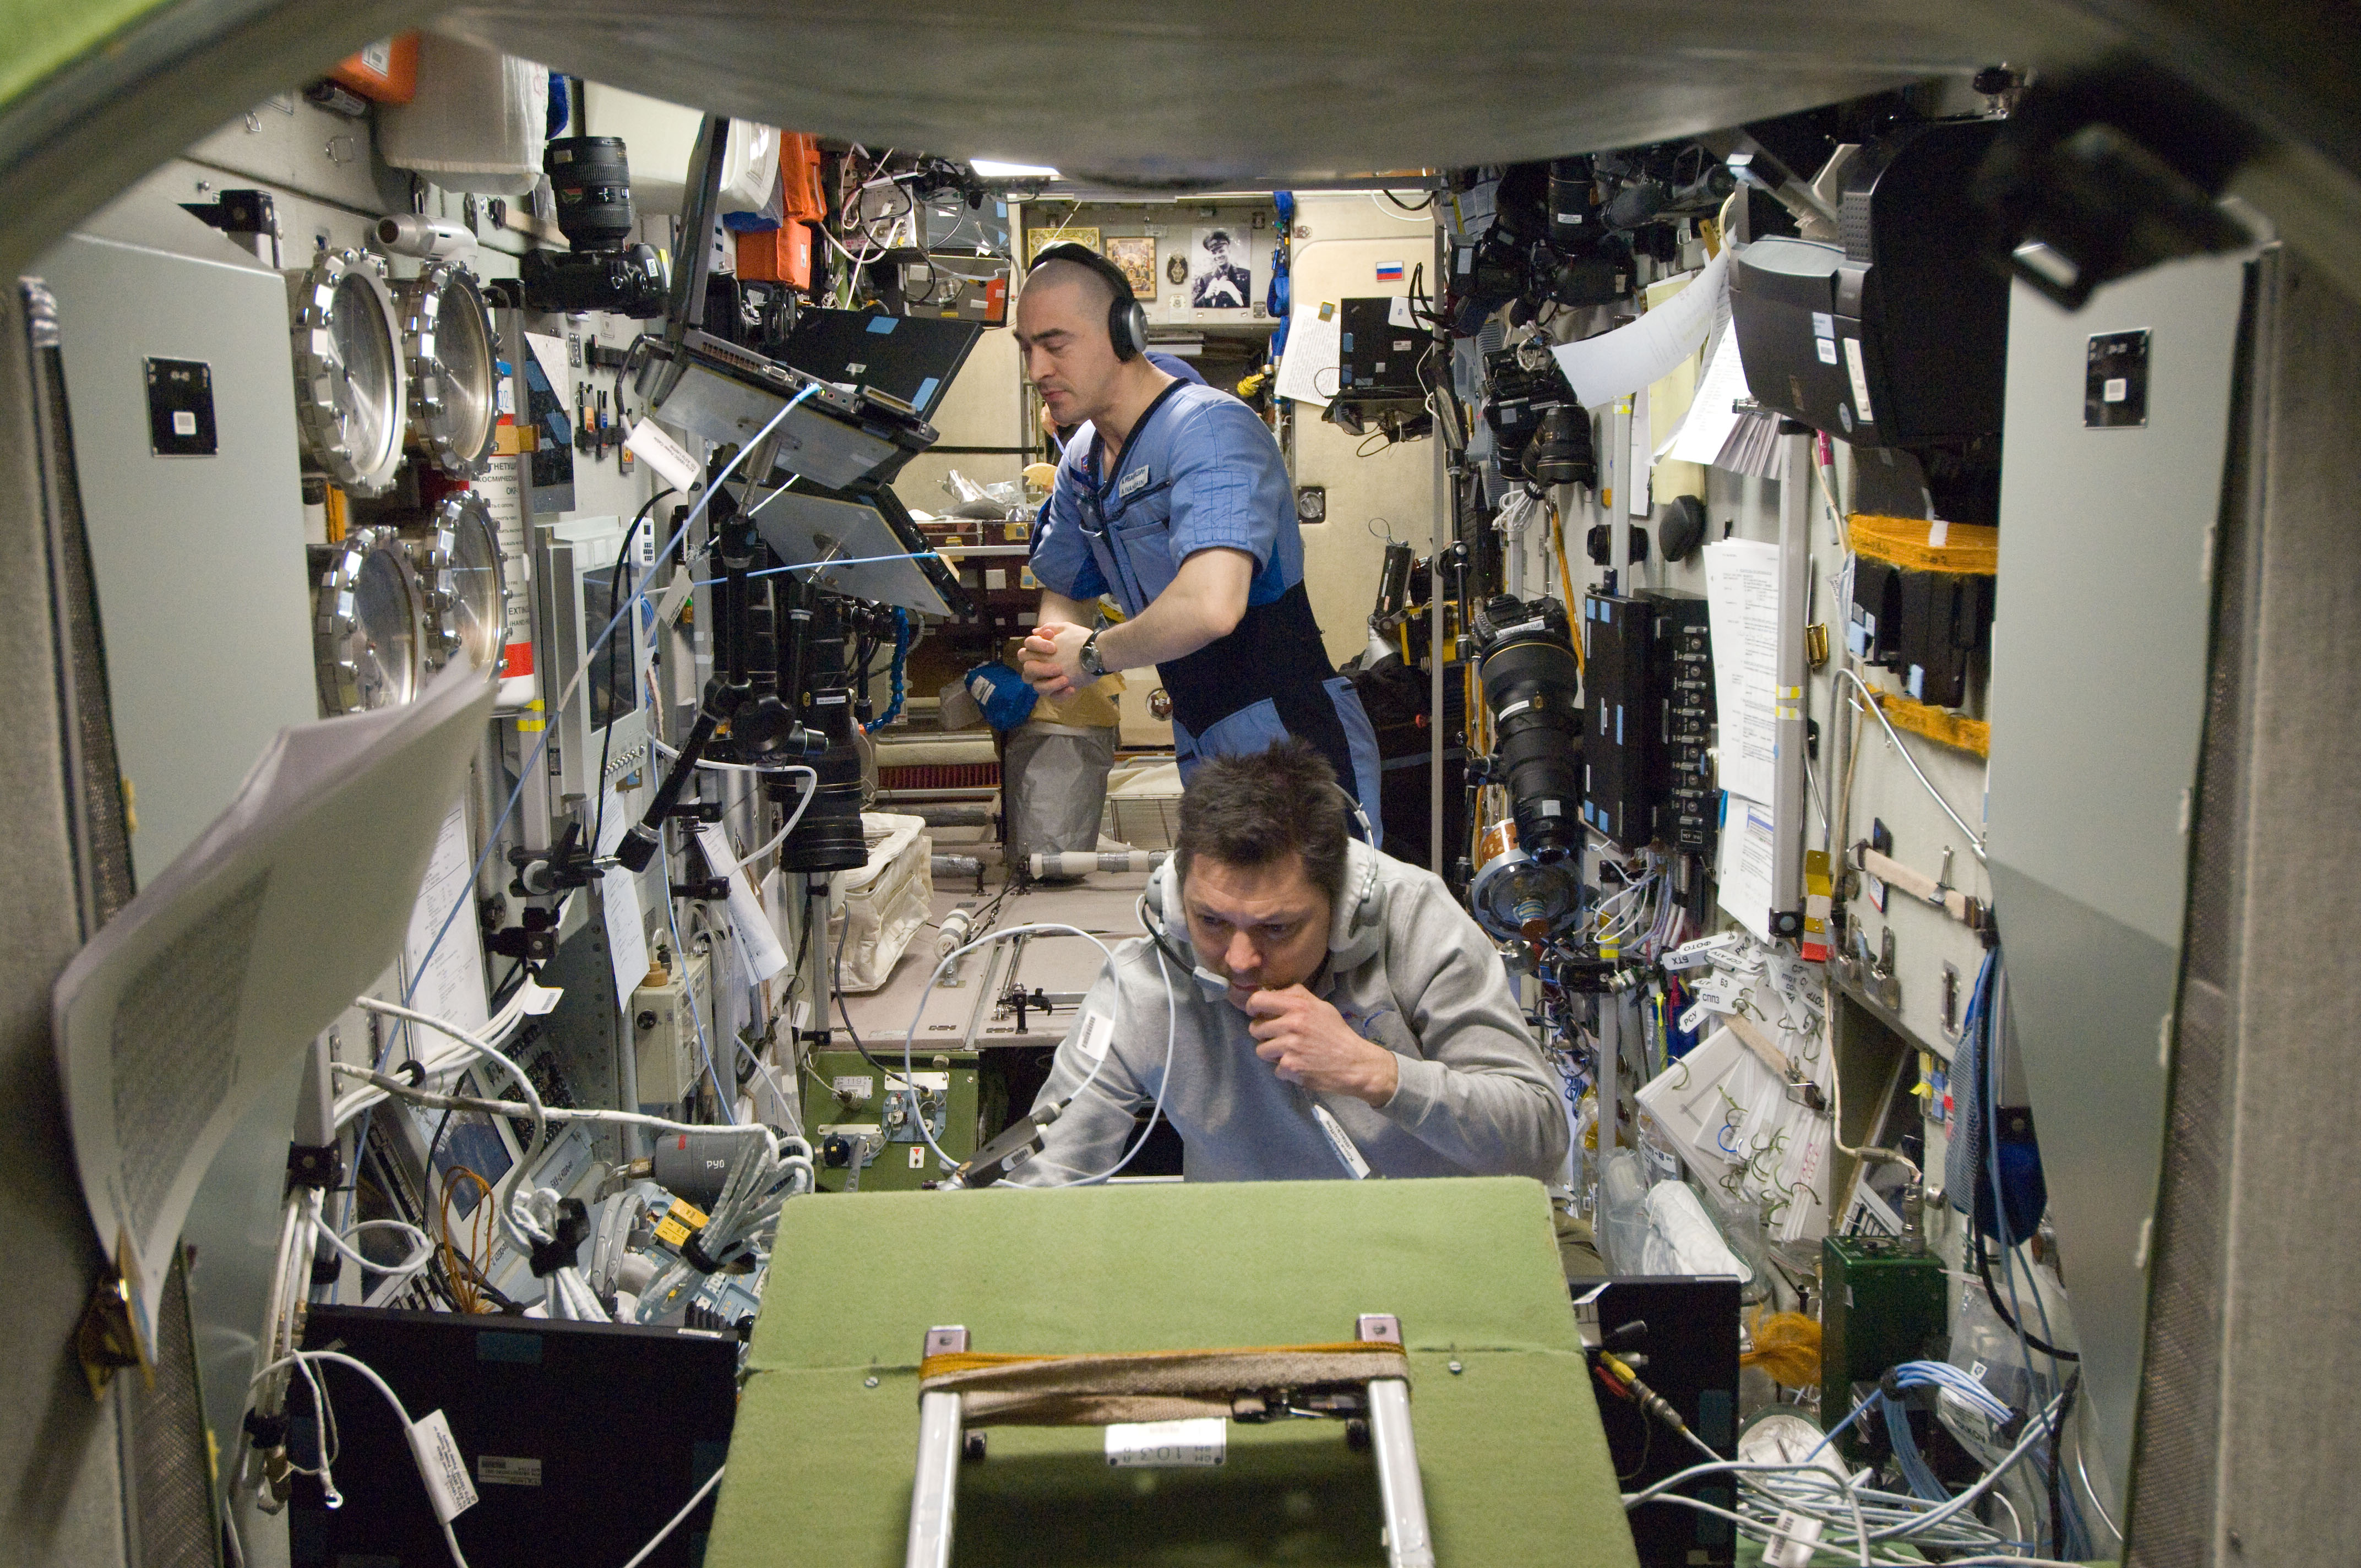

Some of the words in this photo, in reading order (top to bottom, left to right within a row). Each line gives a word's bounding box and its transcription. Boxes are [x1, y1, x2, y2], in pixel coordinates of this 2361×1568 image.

[1499, 628, 1522, 637] AURORA
[1523, 622, 1542, 630] SETUP
[1684, 941, 1711, 951] ФОТО
[1684, 1010, 1697, 1025] РСУ
